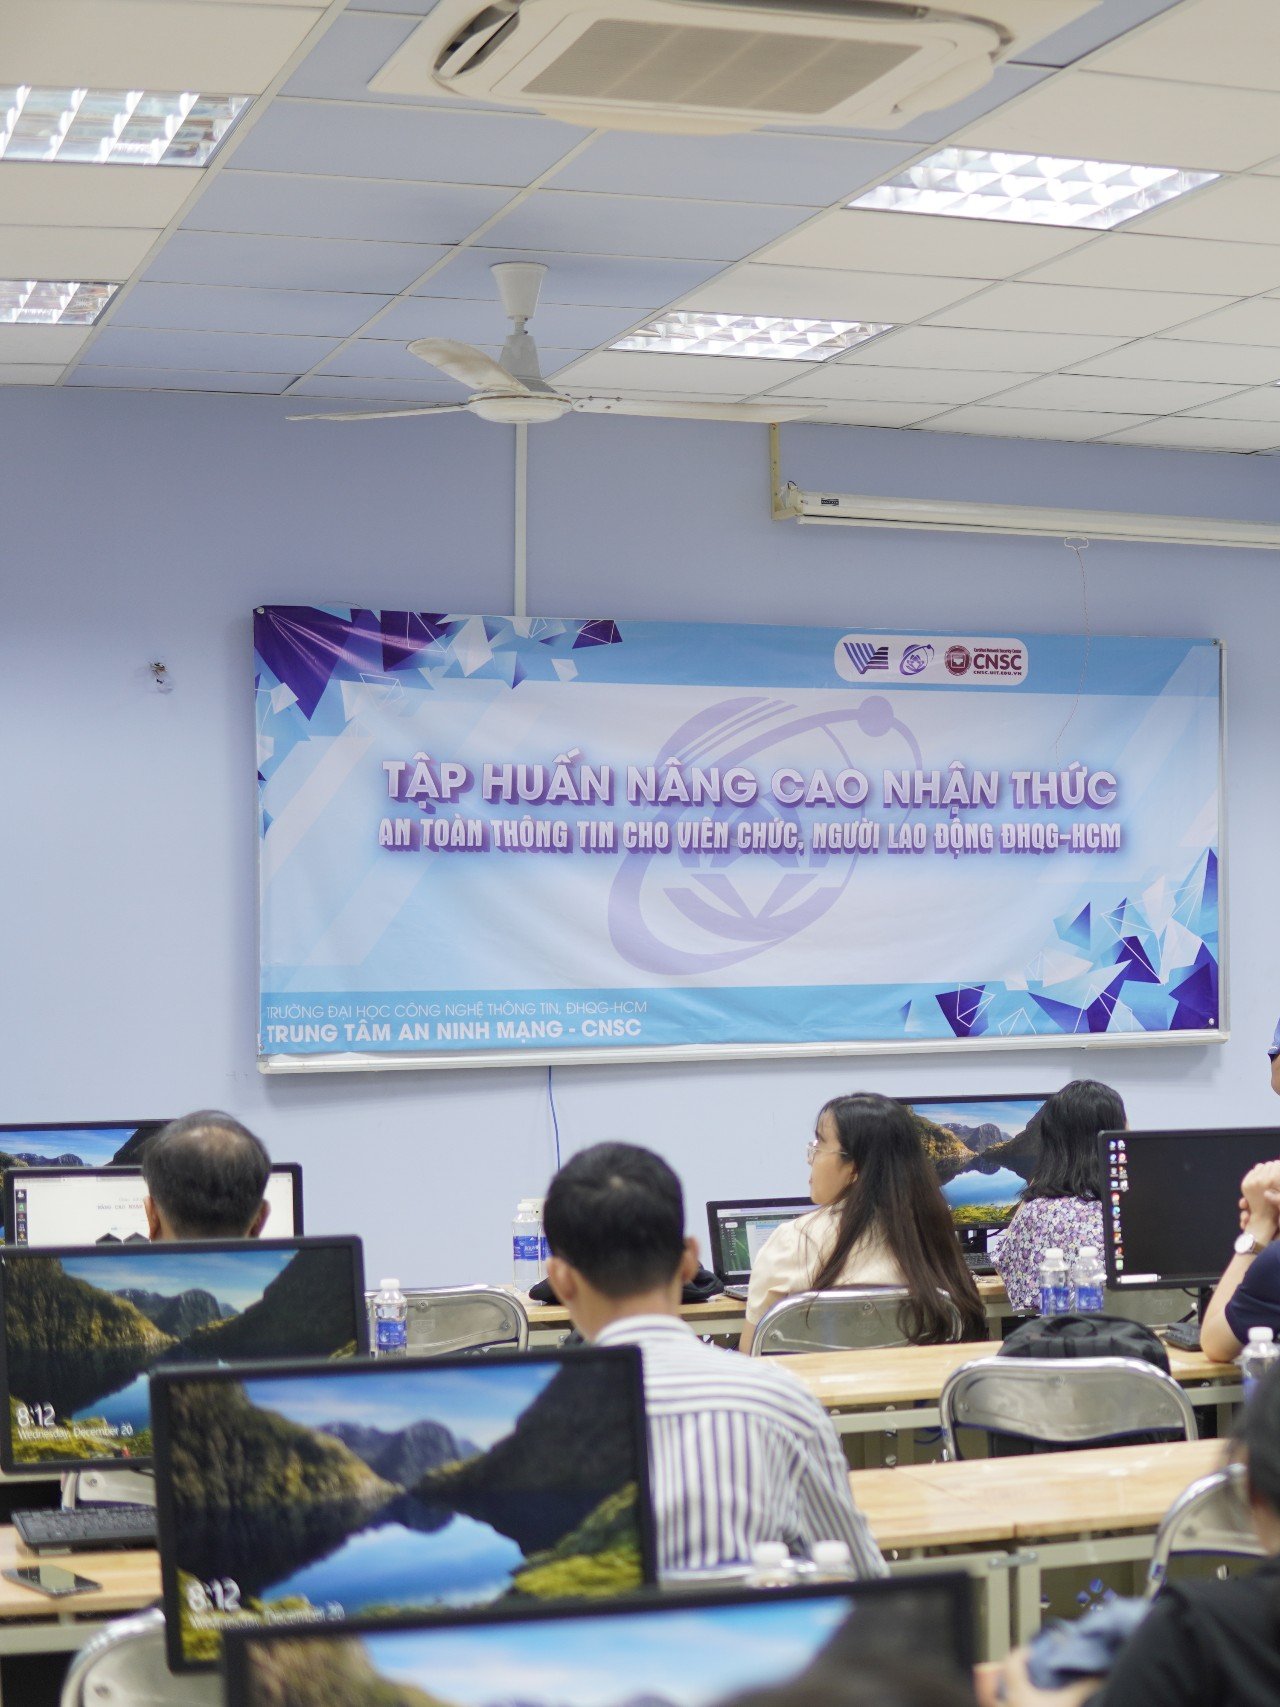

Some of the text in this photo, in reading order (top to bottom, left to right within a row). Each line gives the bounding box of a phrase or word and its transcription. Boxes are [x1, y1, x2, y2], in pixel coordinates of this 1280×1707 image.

[973, 654, 1022, 670] CNSC
[383, 747, 1117, 815] TẬP HUẤN NÂNG CAO NHẬN THỨC
[378, 812, 1121, 854] AN TOÀN THÔNG TIN CHO VIÊN CHỨC, NGƯỜI LAO ĐỘNG ĐHQG-HCM
[267, 1003, 324, 1019] TRƯỜNG
[327, 1005, 352, 1021] ĐẠI
[356, 1004, 391, 1021] HỌC
[394, 1002, 441, 1018] CÔNG
[445, 1001, 484, 1019] NGHỆ
[487, 1000, 536, 1016] THÔNG
[540, 1002, 562, 1016] TIN,
[267, 1023, 338, 1043] TRUNG
[344, 1019, 392, 1042] TÂM
[398, 1023, 430, 1041] AN
[437, 1021, 490, 1040] NINH
[496, 1020, 564, 1044] MẠNG
[581, 1018, 642, 1038] CNSC
[16, 1401, 56, 1429] 8:12
[120, 1421, 134, 1437] 20
